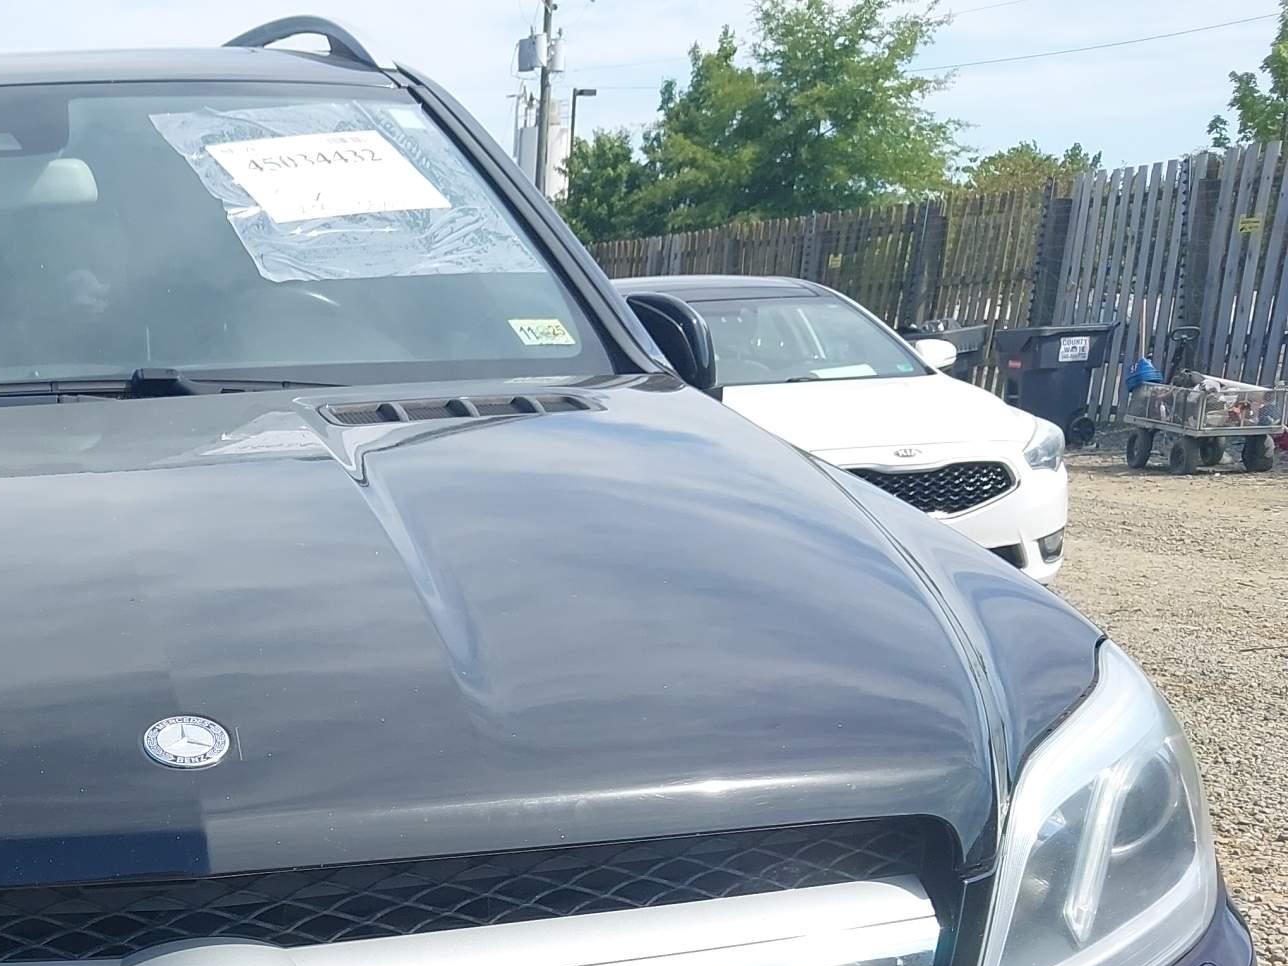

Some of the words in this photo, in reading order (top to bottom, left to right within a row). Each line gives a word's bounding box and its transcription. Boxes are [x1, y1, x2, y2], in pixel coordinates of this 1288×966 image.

[248, 148, 382, 171] 45034432
[155, 716, 209, 730] MERCEDES
[176, 755, 207, 764] BENZ
